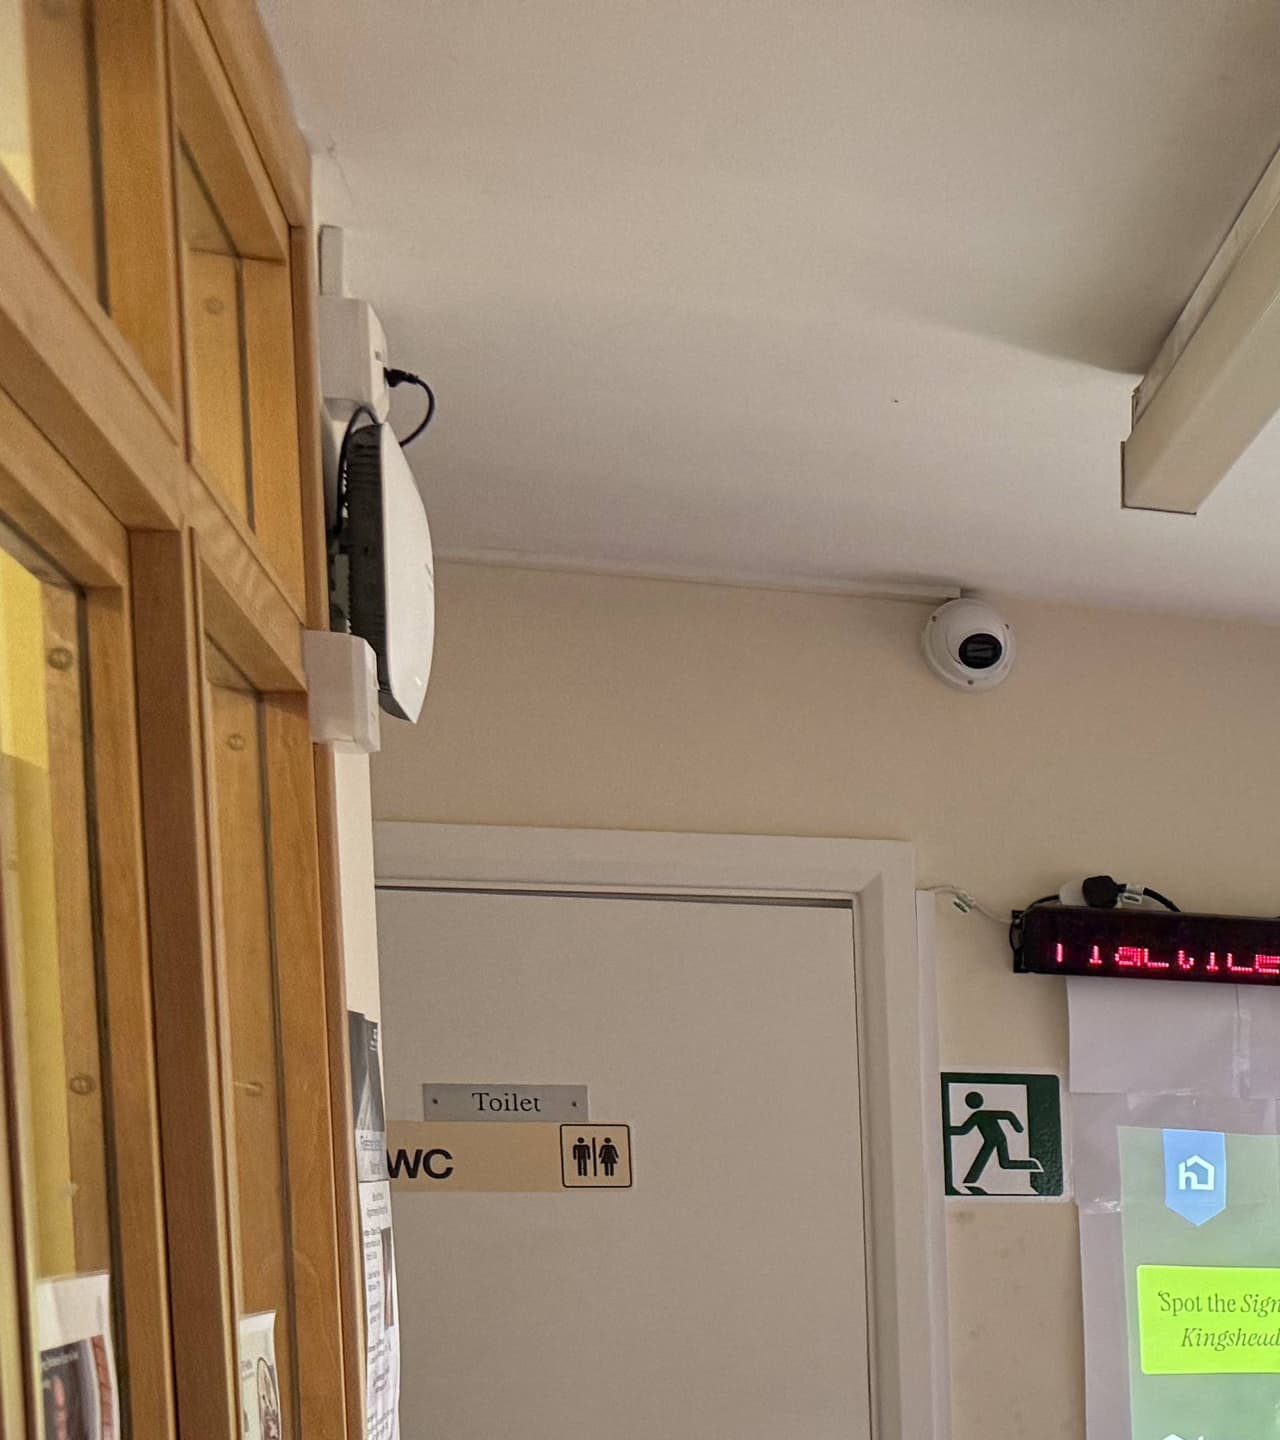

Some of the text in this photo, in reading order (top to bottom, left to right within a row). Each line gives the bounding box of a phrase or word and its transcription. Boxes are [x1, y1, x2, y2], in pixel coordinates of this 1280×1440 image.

[471, 1092, 541, 1112] Toilet
[386, 1148, 454, 1179] WC
[1207, 1293, 1236, 1313] the
